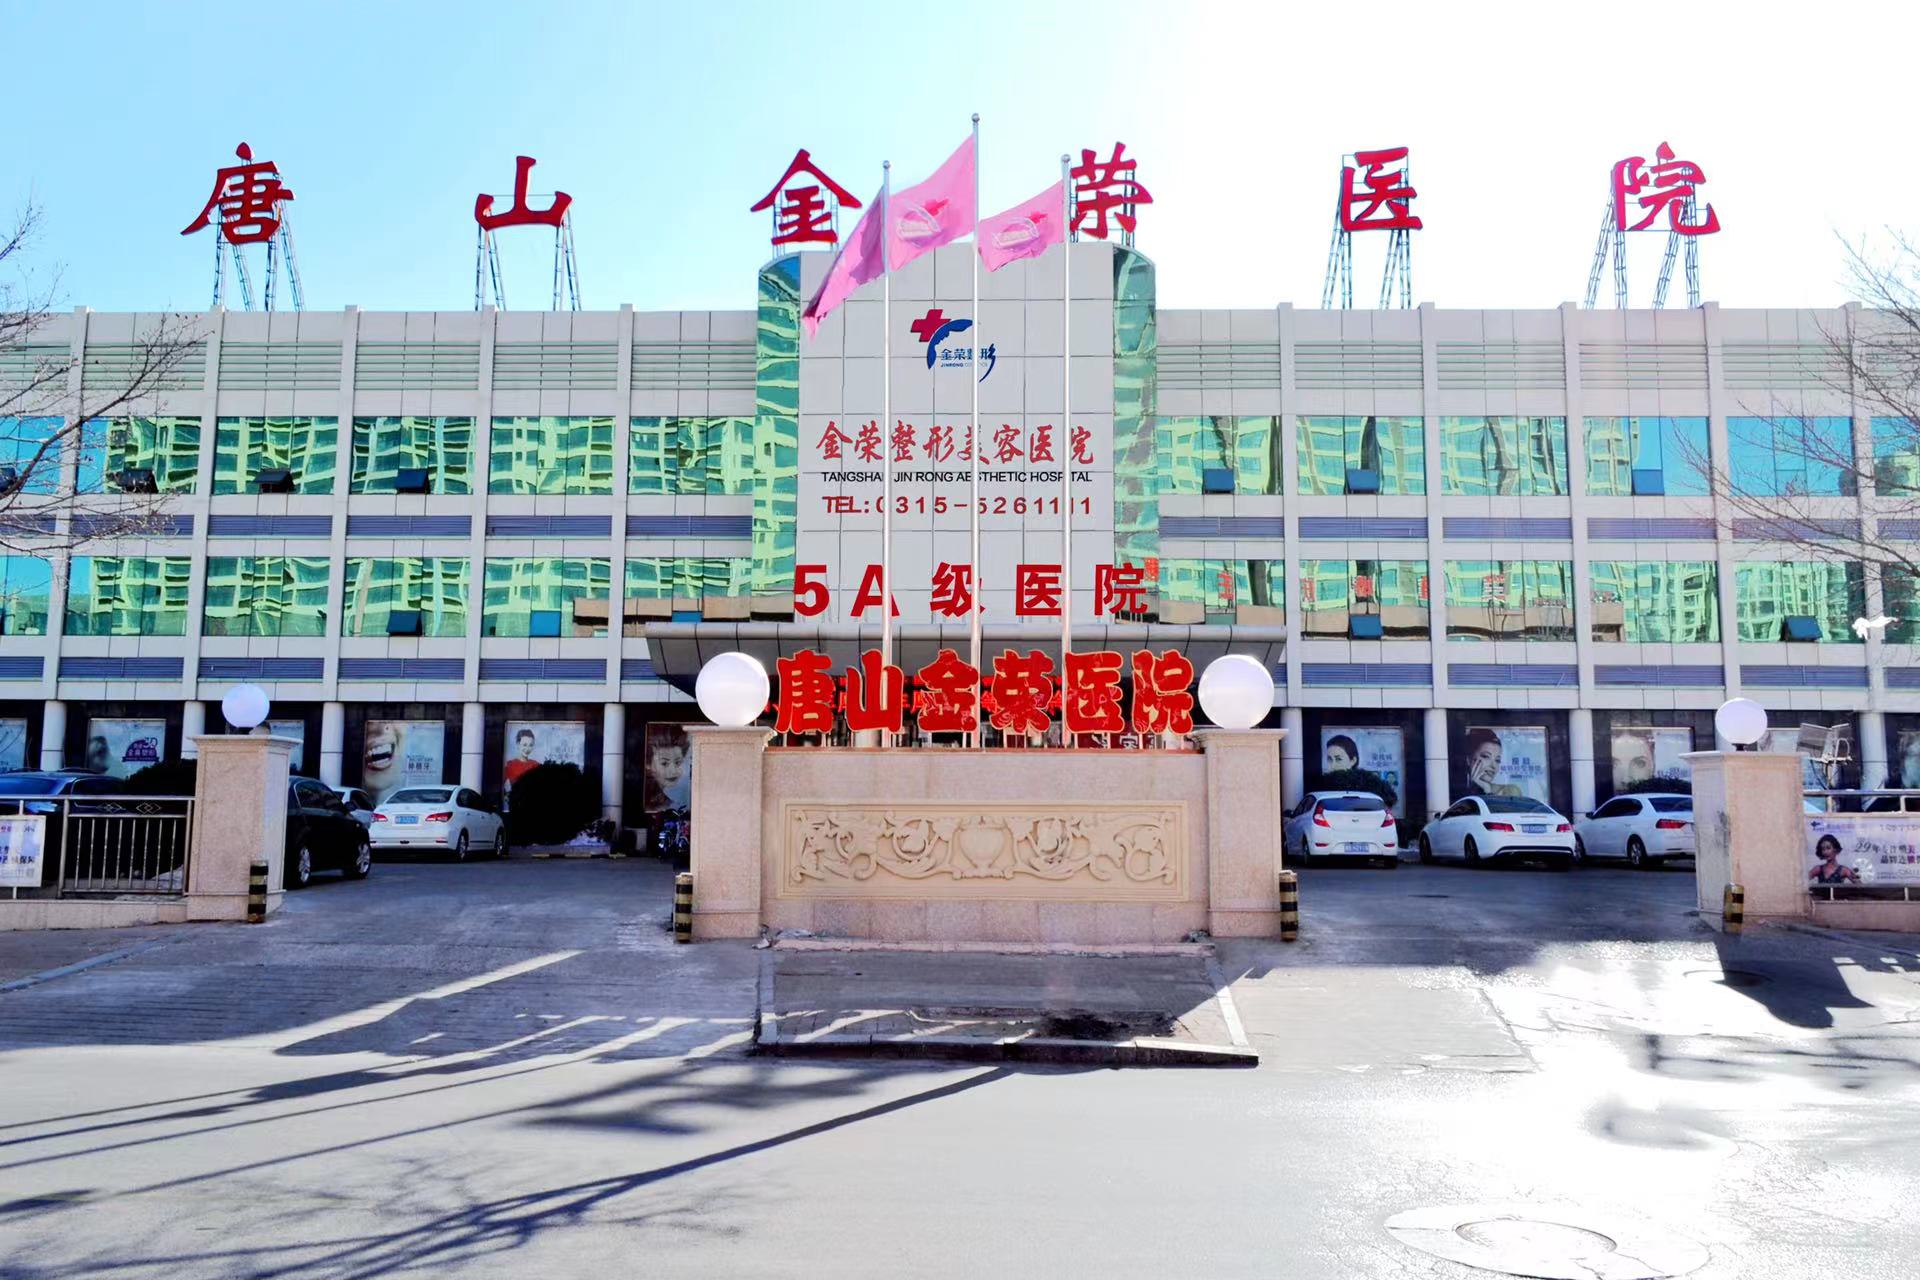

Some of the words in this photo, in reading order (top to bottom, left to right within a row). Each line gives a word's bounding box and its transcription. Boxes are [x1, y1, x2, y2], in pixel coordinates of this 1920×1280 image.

[180, 141, 1721, 246] 唐山金荣医院
[816, 420, 1094, 465] 金荣整形美容医院
[822, 471, 884, 483] TANGSHA
[893, 471, 913, 483] JIN
[915, 471, 954, 483] RONG
[1030, 471, 1093, 483] HOSPTAL
[794, 562, 1149, 617] 5A级医院
[774, 648, 1195, 736] 唐山金荣医院
